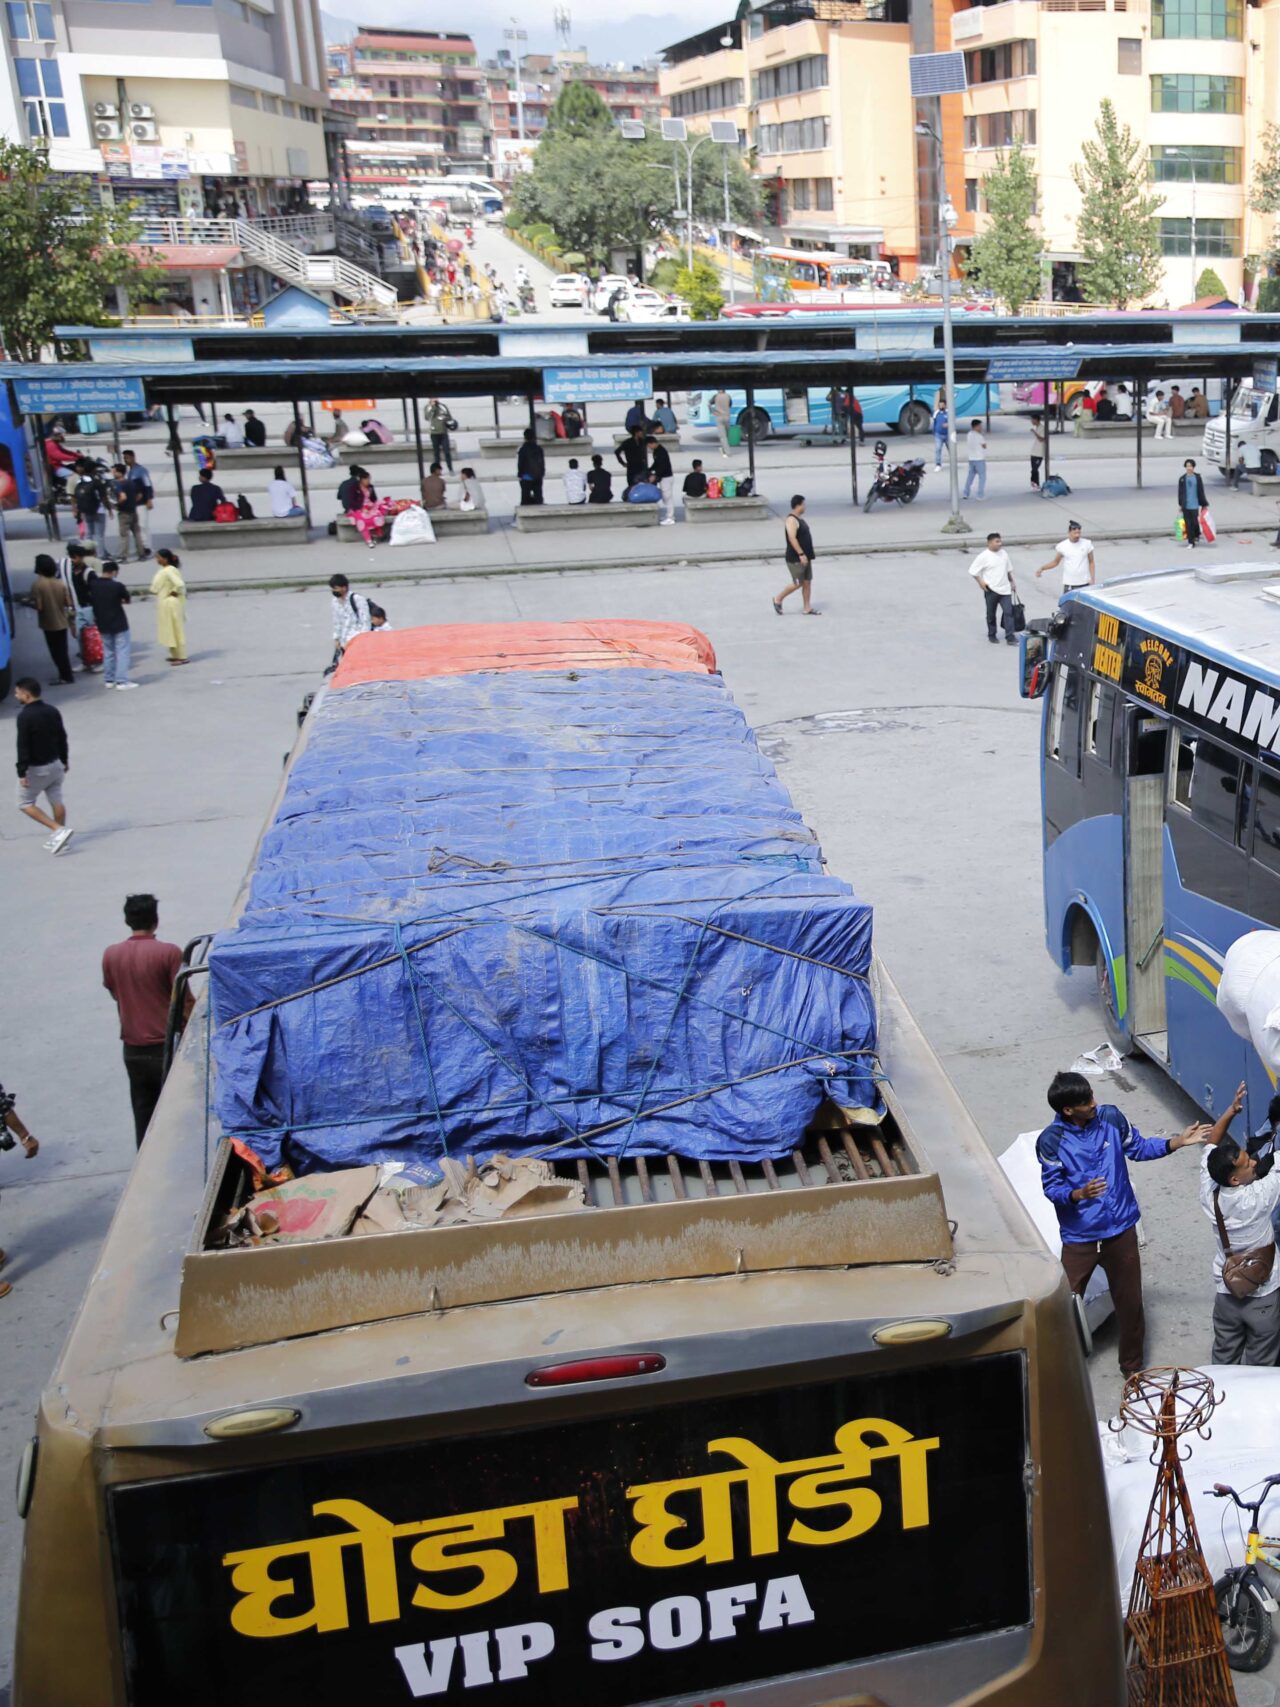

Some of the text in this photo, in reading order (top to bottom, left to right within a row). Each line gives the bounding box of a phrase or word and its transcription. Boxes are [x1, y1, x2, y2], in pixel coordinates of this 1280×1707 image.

[1097, 613, 1120, 646] WITH
[1094, 643, 1122, 682] HEATER
[1140, 639, 1174, 667] WELCOME
[223, 1417, 940, 1638] घोडा घोडी
[395, 1574, 815, 1697] VIP SOFA
